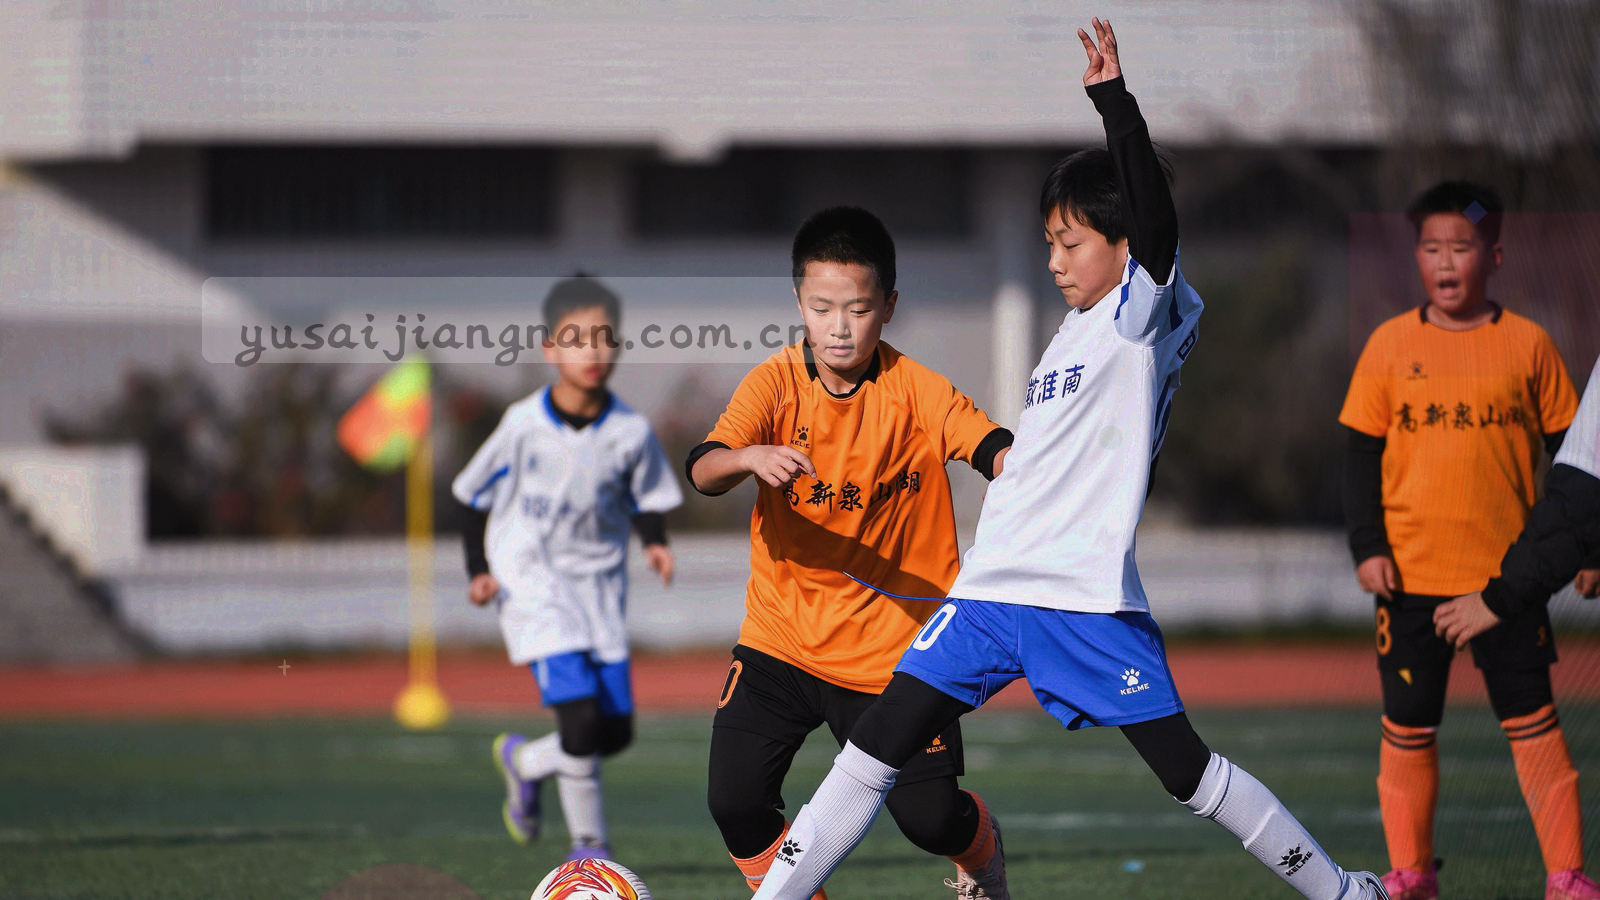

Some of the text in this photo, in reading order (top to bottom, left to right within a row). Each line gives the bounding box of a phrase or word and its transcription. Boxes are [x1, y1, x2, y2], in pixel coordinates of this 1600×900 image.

[1376, 606, 1393, 656] 8
[1120, 682, 1150, 696] KELME
[1285, 850, 1313, 877] KELME
